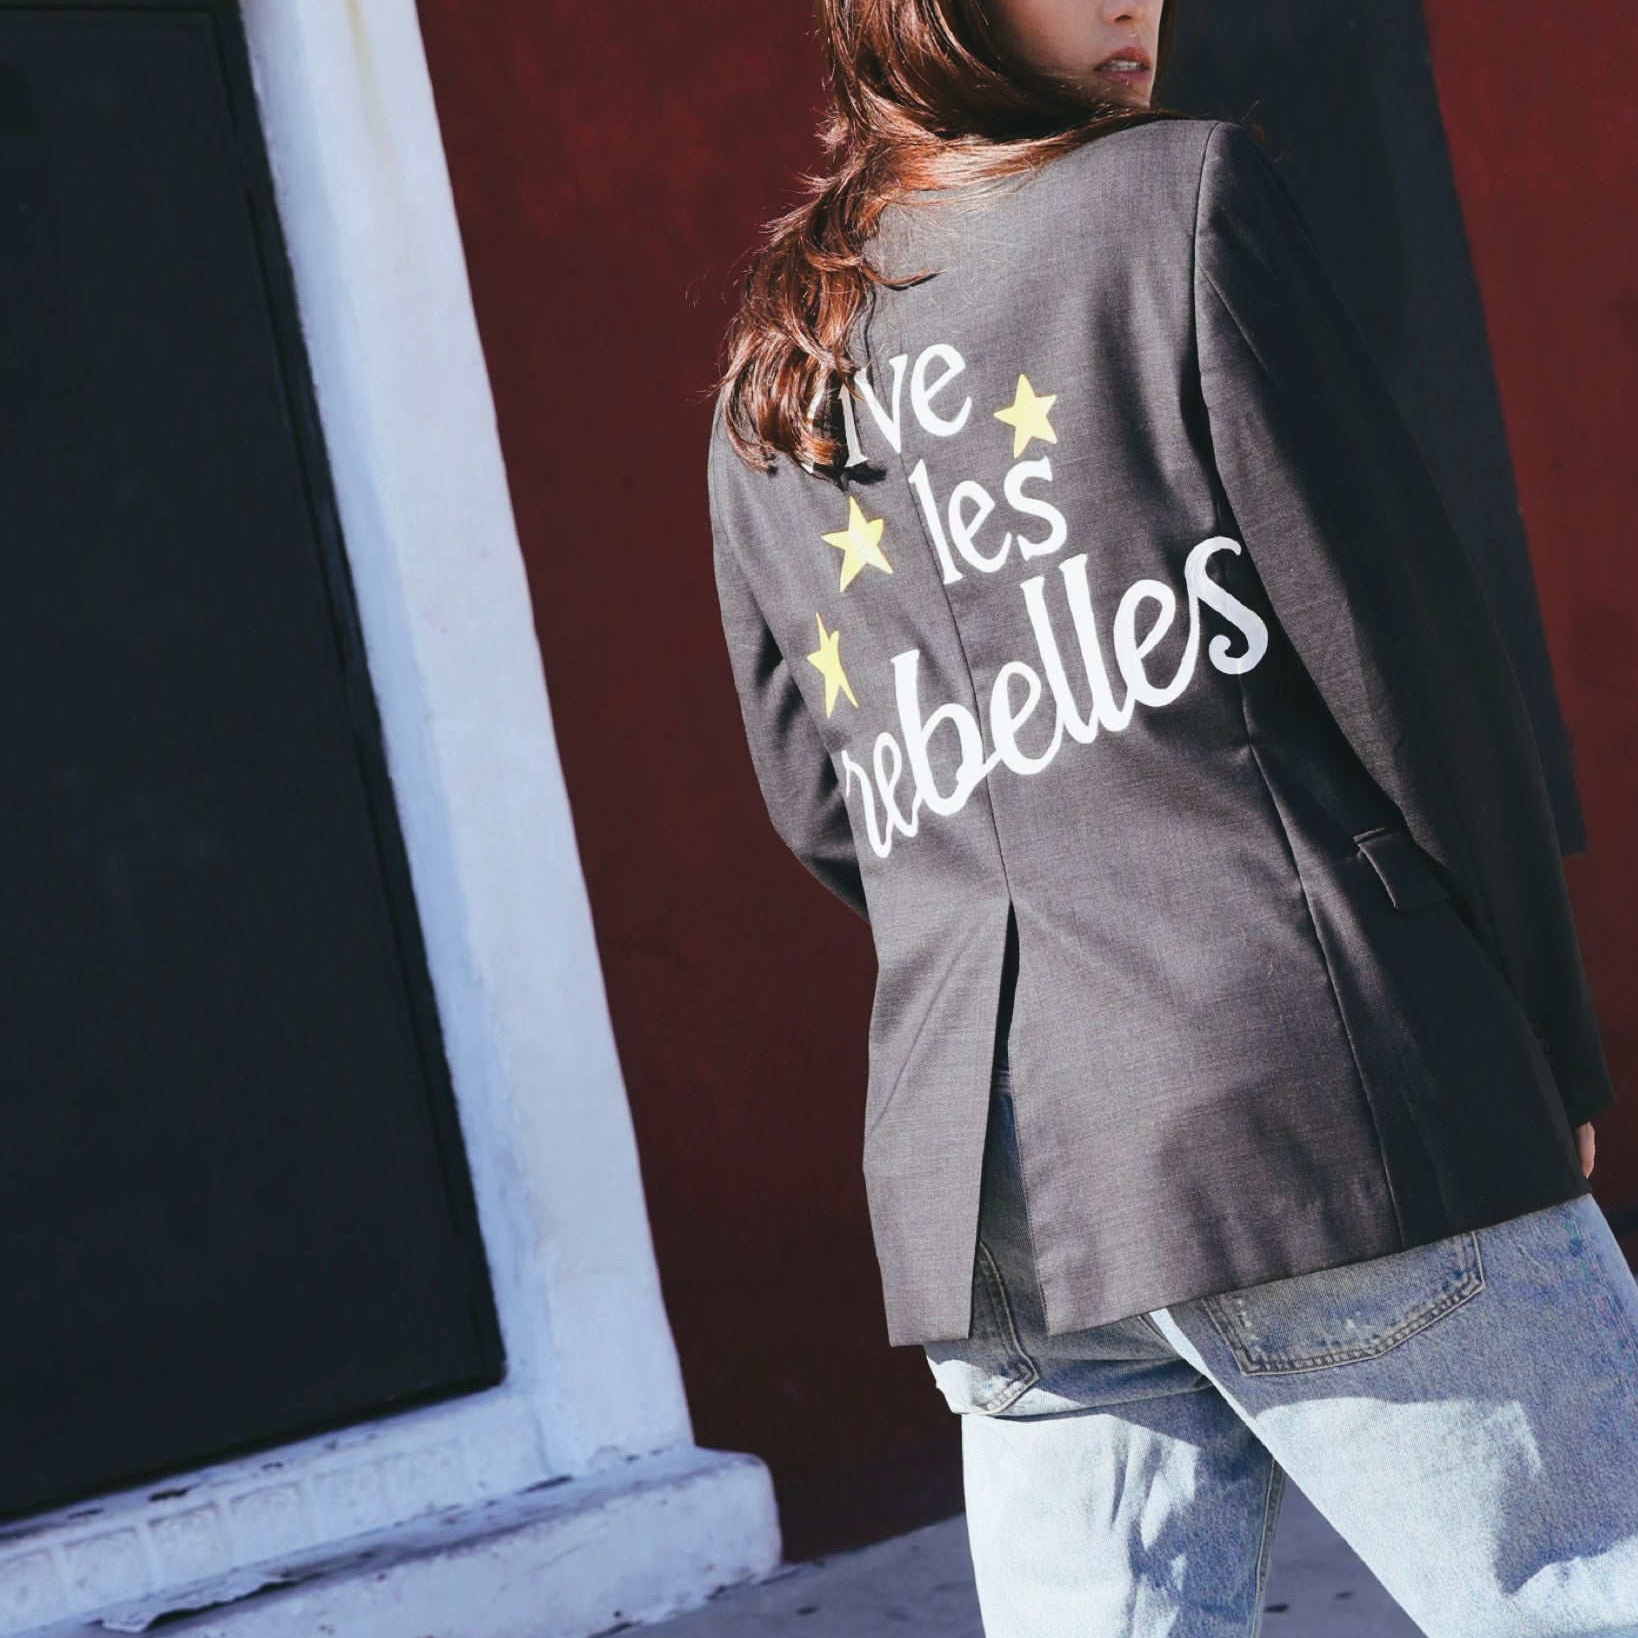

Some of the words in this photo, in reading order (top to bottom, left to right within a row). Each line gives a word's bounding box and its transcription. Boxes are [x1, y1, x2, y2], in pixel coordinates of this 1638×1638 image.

[804, 343, 973, 469] ive
[907, 455, 1068, 585] les
[841, 535, 1269, 859] rebelles
